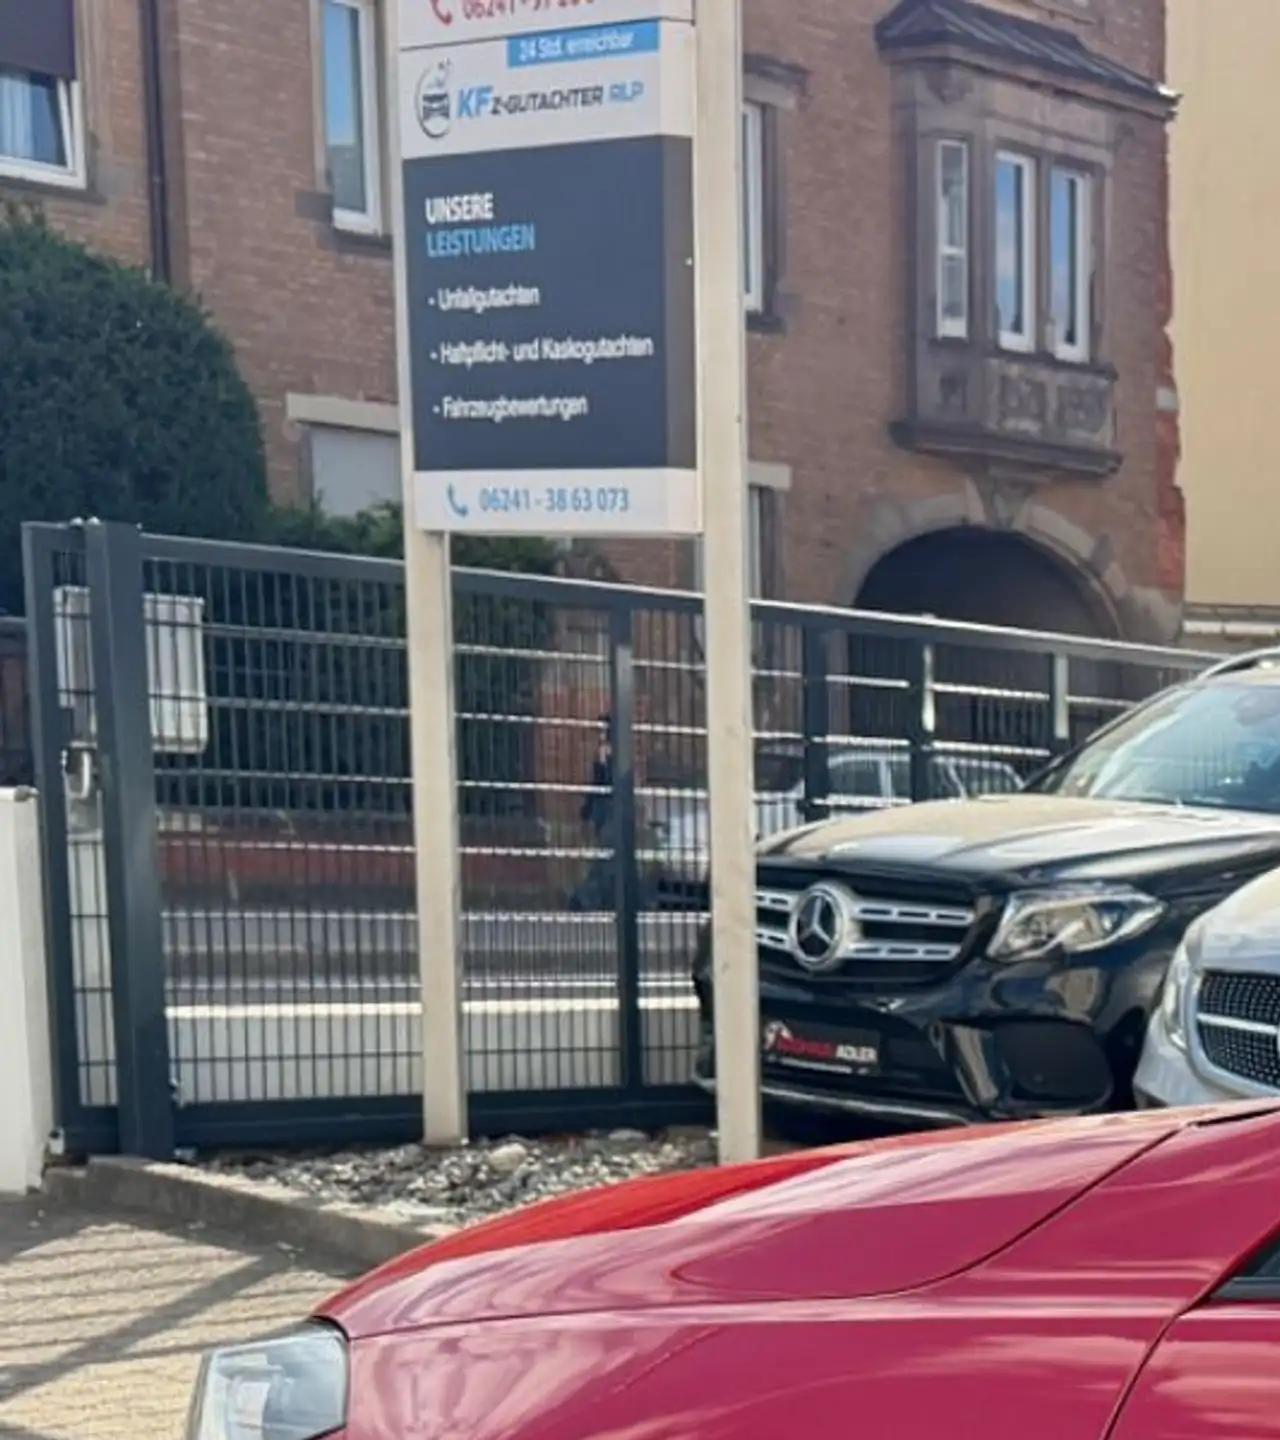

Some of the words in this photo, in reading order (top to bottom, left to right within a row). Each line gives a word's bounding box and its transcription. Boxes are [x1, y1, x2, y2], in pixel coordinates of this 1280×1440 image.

[425, 192, 495, 225] UNSERE
[426, 223, 535, 257] LEISTUNGEN
[438, 280, 541, 313] Unfallgutachten
[512, 338, 539, 361] und
[541, 333, 655, 365] Kaskogutachten
[442, 395, 588, 423] Fahrzeugbewertungen
[479, 486, 531, 512] 06241
